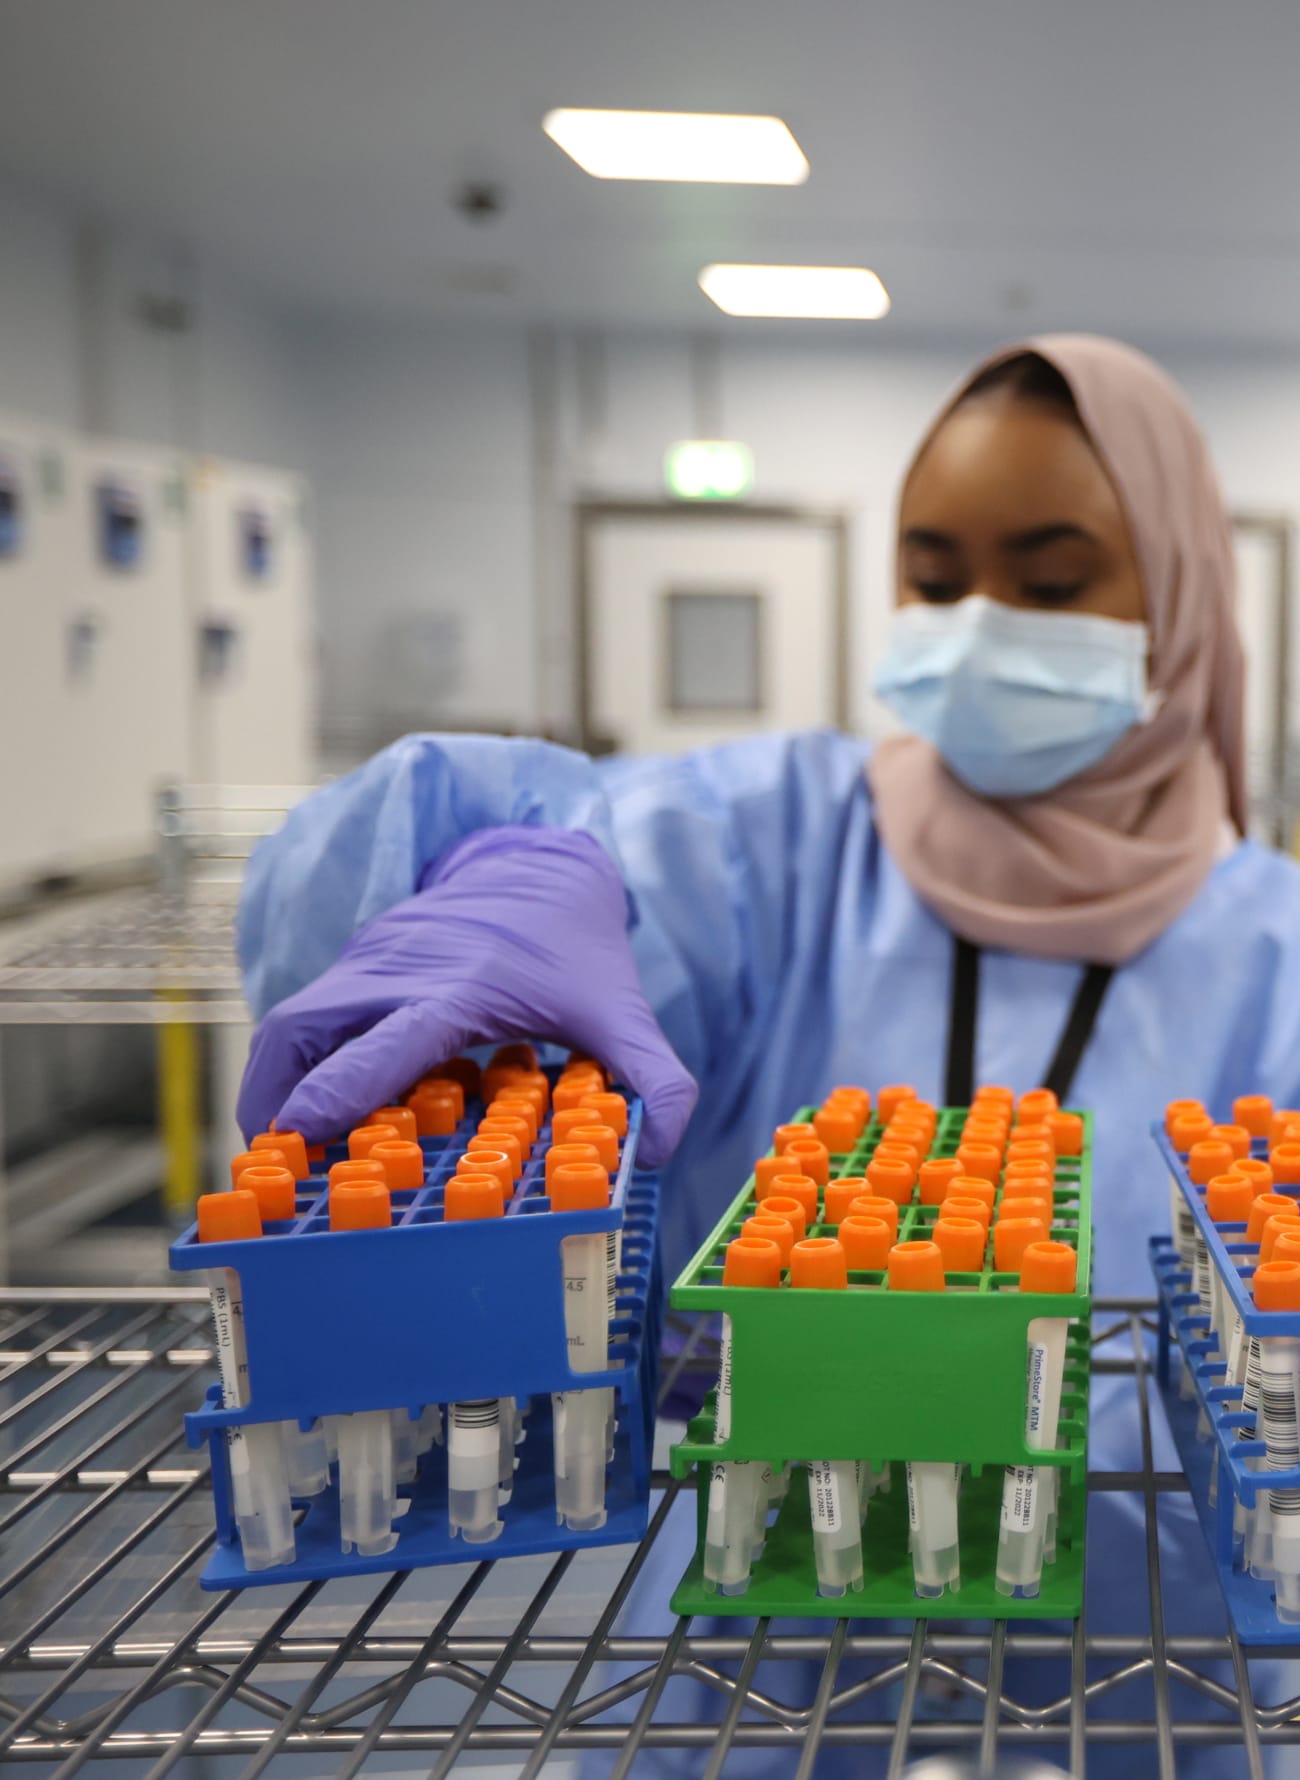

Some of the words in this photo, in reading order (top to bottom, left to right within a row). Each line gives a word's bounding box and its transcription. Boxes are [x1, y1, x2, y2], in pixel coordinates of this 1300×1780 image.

[565, 1281, 584, 1292] 4.5
[215, 1287, 226, 1310] PBS
[1029, 1406, 1040, 1432] MTM
